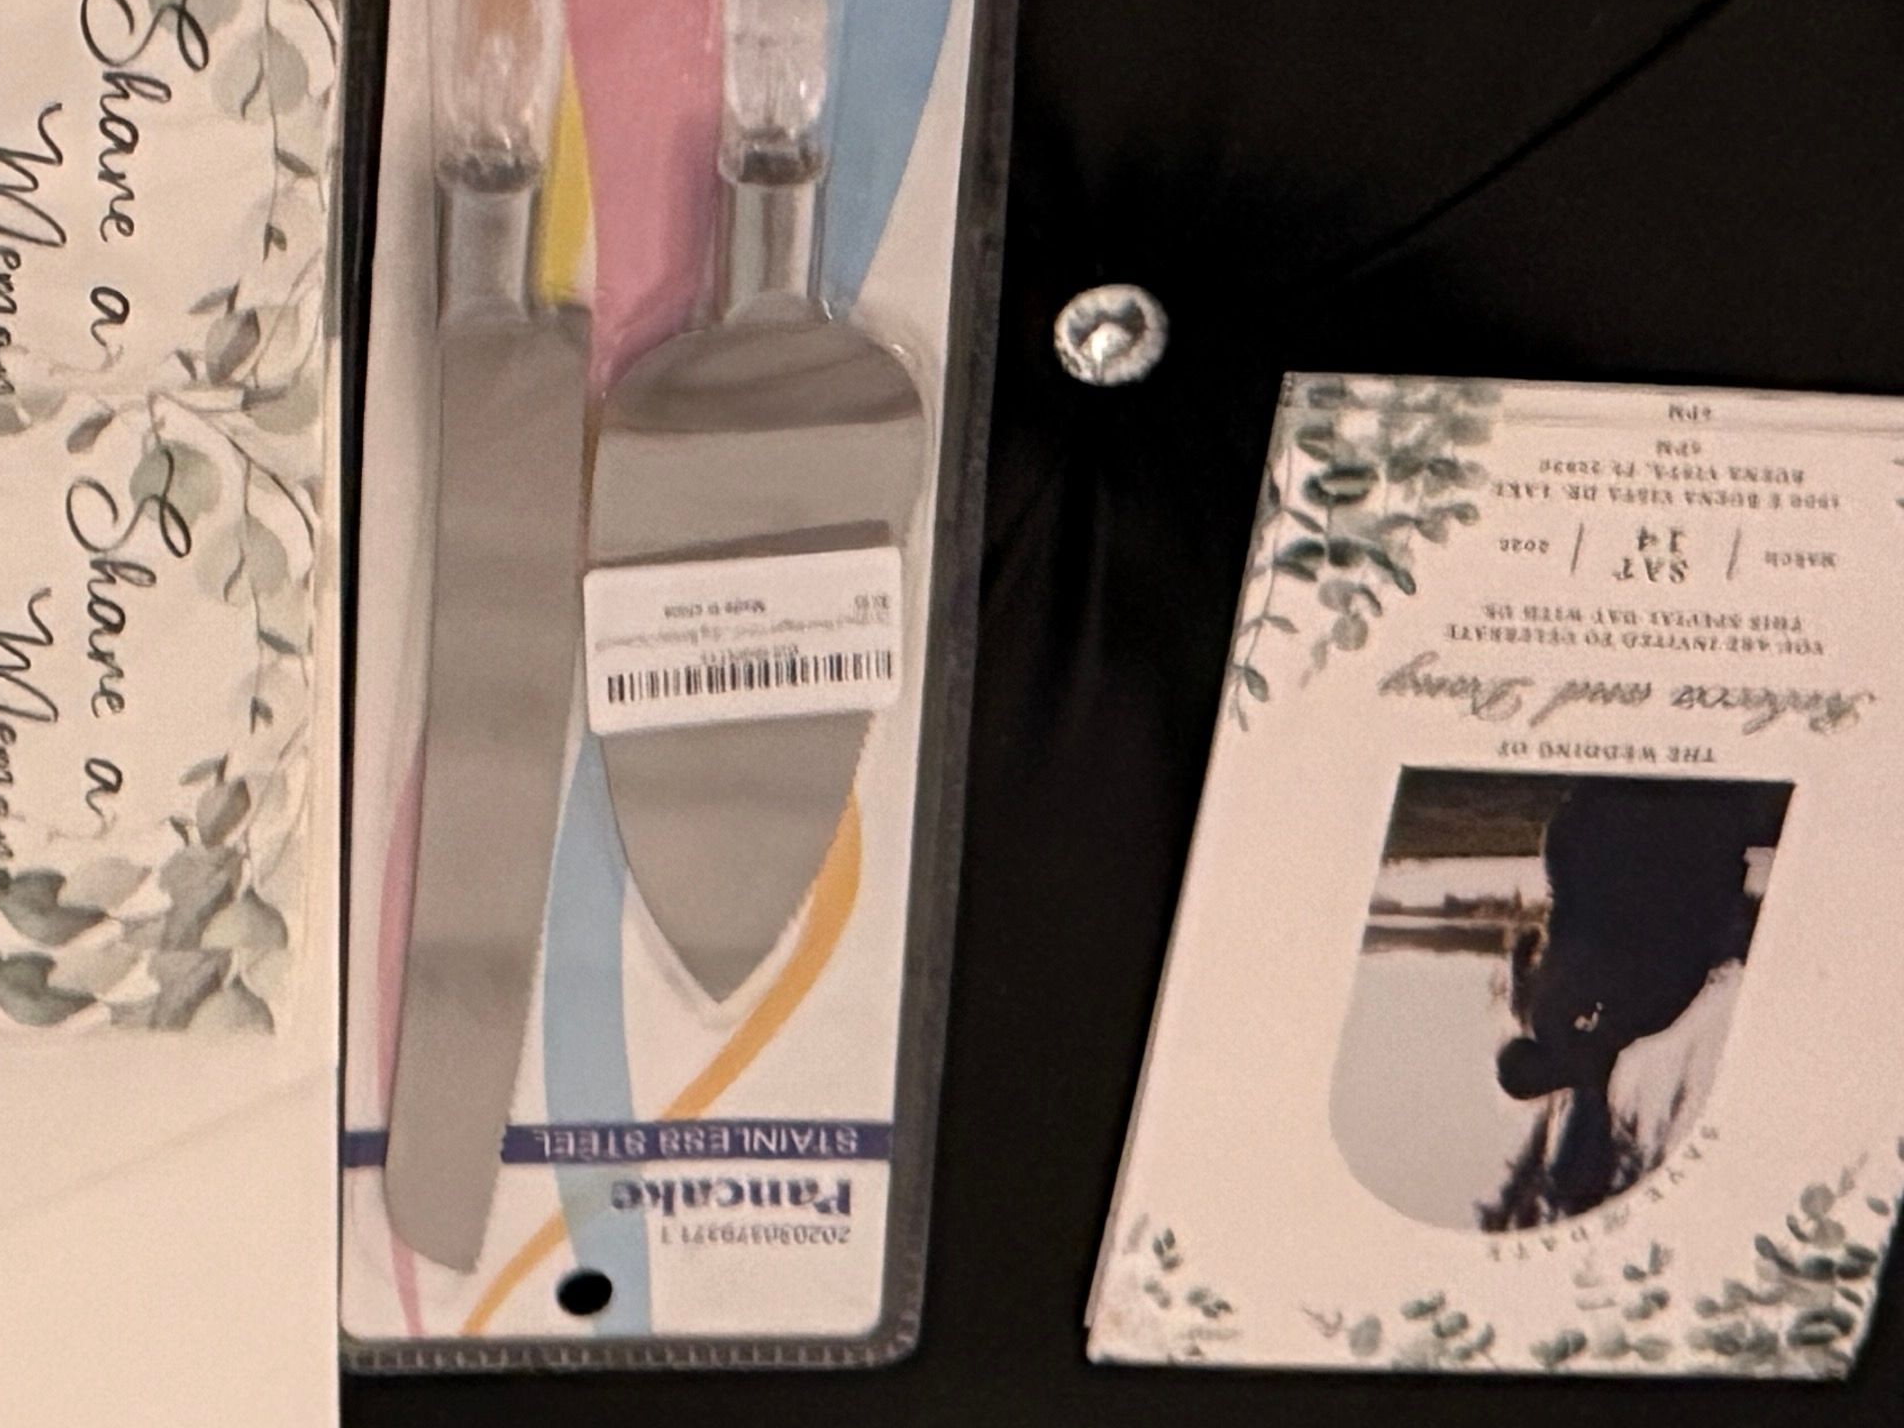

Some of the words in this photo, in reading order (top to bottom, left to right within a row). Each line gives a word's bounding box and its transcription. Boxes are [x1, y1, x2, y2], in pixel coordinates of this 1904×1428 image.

[89, 285, 133, 349] a
[1728, 465, 1805, 484] BUENA
[1488, 481, 1552, 500] LAKE
[1608, 487, 1674, 505] VISTA
[1682, 489, 1760, 509] BUENA
[1635, 527, 1686, 554] 14
[1763, 550, 1838, 570] MARCH
[1611, 557, 1690, 585] SAT
[65, 448, 193, 719] Share
[1521, 605, 1582, 623] WITH
[1593, 608, 1636, 625] DAY
[1648, 610, 1742, 630] SPECIAL
[1749, 614, 1802, 632] THIS
[1442, 624, 1576, 644] CELEBRATE
[1584, 630, 1612, 645] TO
[1620, 632, 1719, 651] INVITED
[1726, 636, 1771, 652] ARE
[1777, 640, 1824, 656] YOU
[1528, 679, 1653, 729] and
[1670, 685, 1876, 736] Rebecca
[1495, 740, 1528, 758] OF
[1538, 740, 1657, 761] WEDDING
[1668, 745, 1716, 763] THE
[84, 757, 128, 816] a
[531, 1127, 647, 1158] STEEL
[657, 1124, 859, 1156] STAINLESS
[610, 1177, 851, 1218] Pancake
